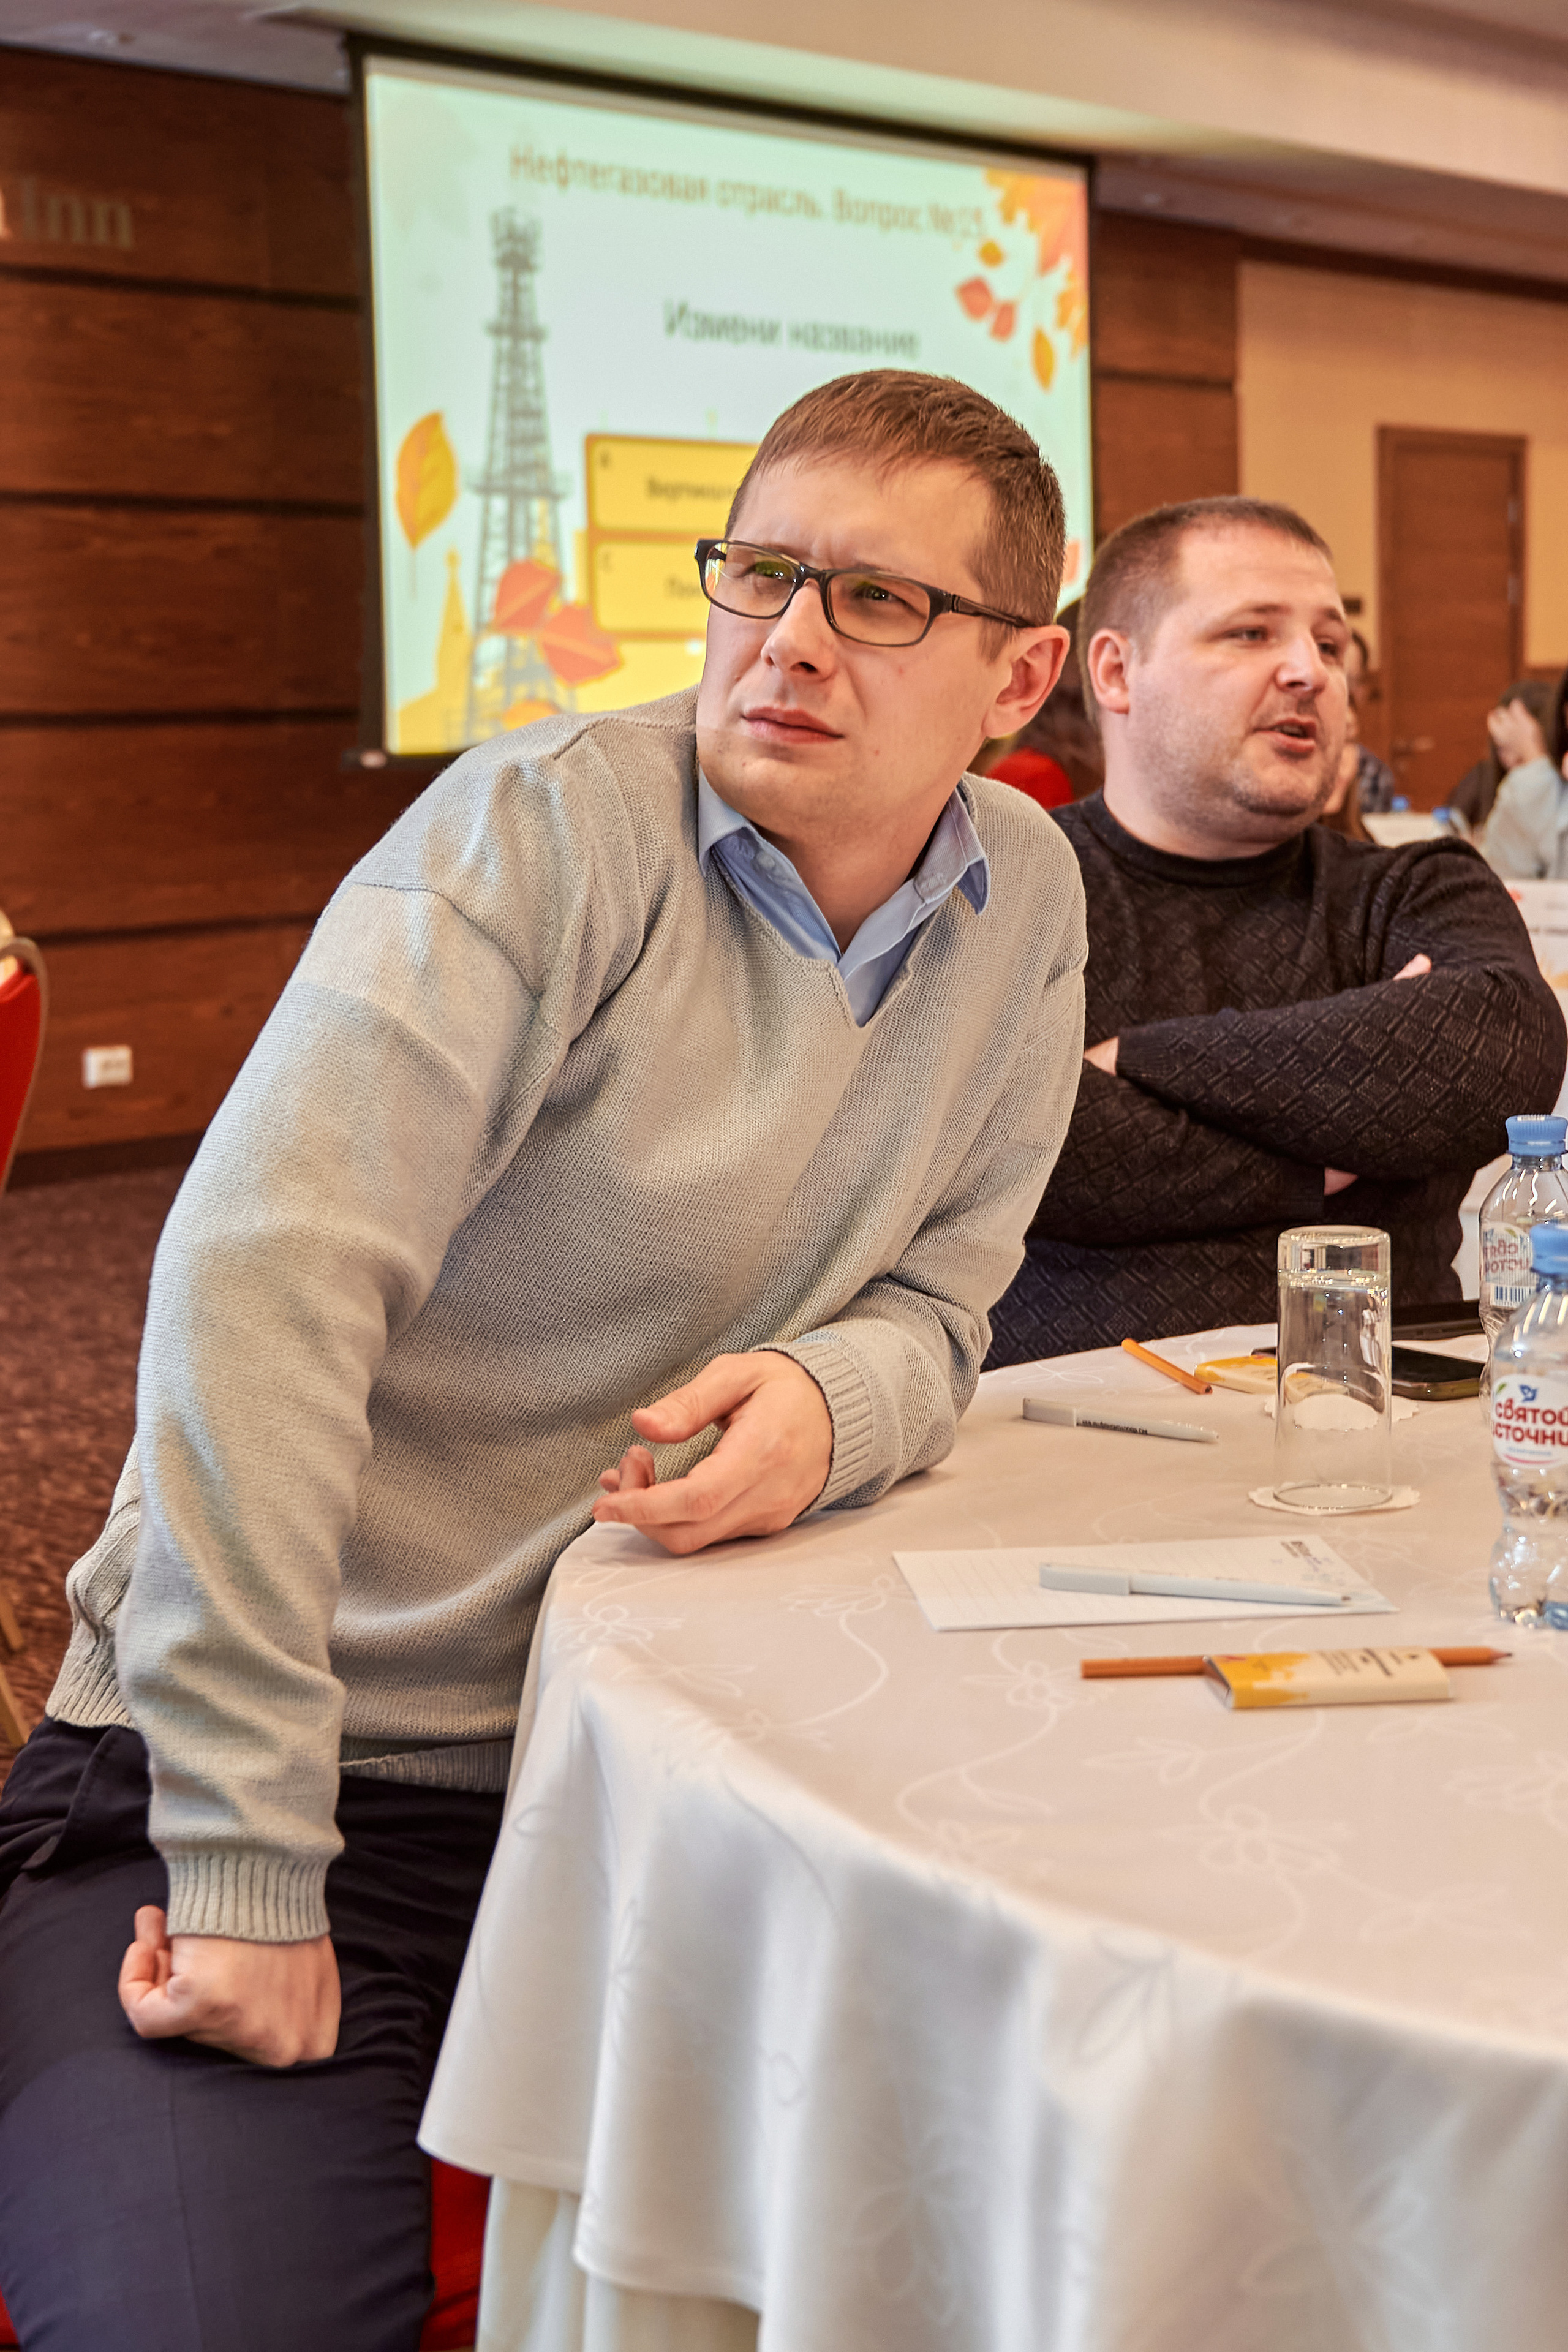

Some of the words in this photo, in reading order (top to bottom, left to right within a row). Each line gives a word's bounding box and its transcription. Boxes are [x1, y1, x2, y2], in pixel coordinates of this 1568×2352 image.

[510, 146, 706, 203] Нефтегазовая
[833, 188, 922, 234] Вопрос
[663, 299, 781, 346] Измени
[788, 321, 920, 360] название
